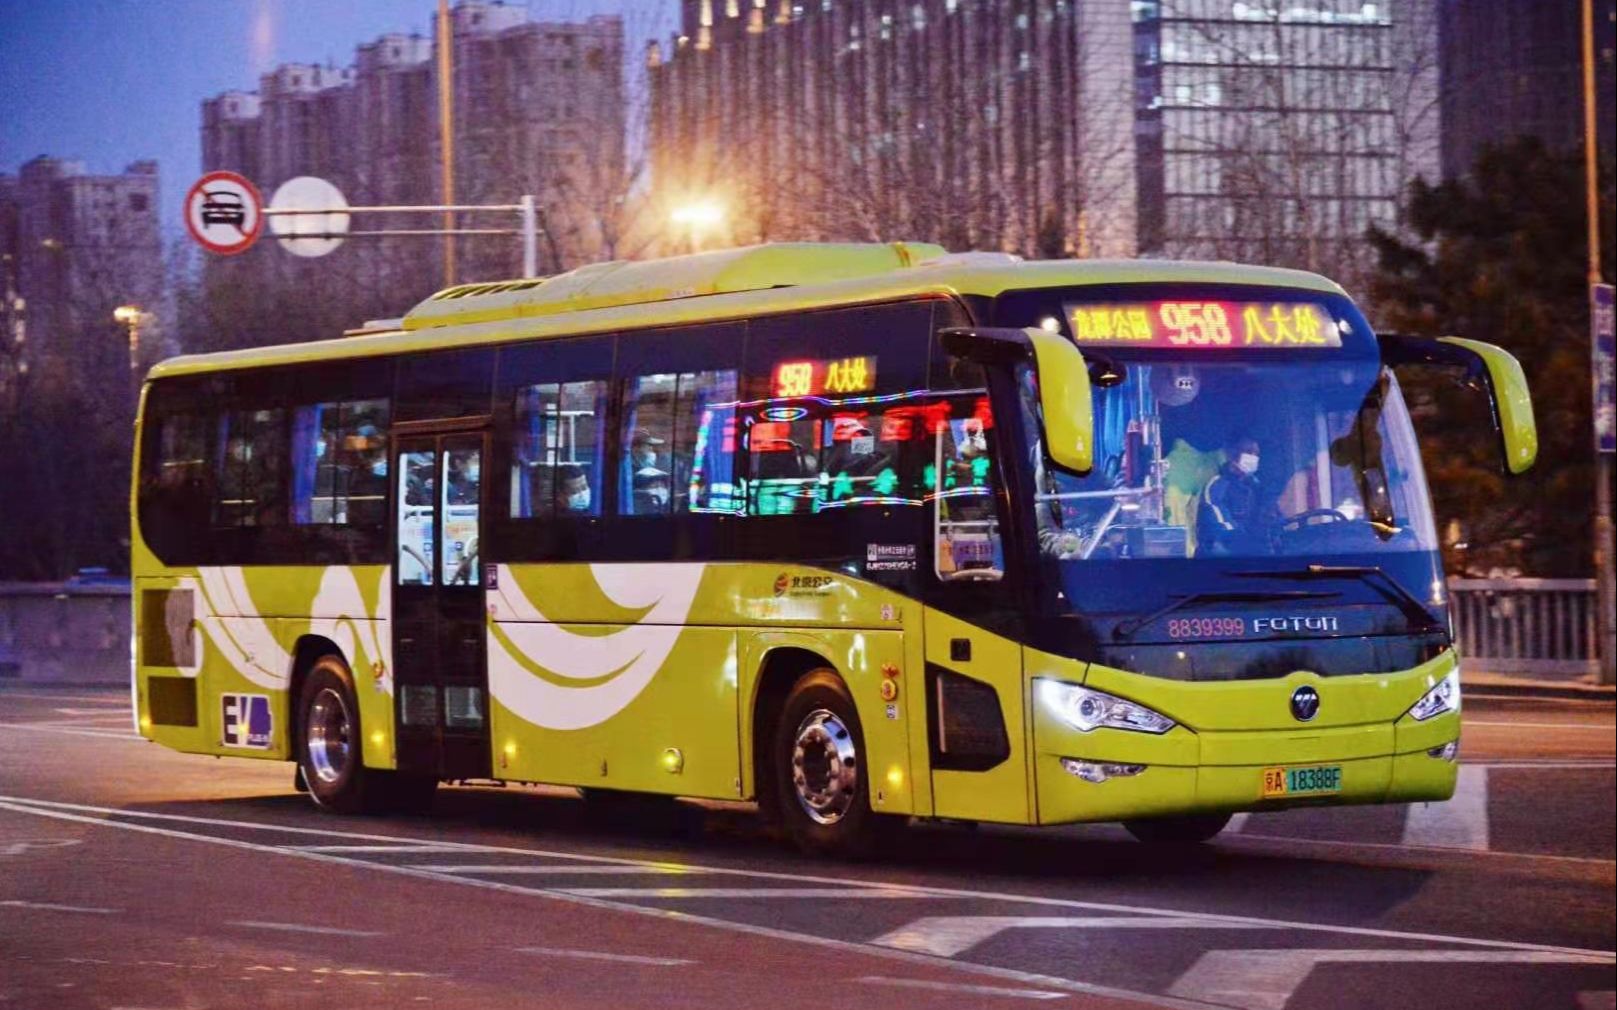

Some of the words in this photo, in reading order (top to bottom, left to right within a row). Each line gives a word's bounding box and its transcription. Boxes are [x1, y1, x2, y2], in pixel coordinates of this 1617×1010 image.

[1159, 302, 1232, 345] 958
[1243, 305, 1326, 344] 八大处
[825, 357, 868, 392] 八大处
[1168, 617, 1245, 638] 8839399
